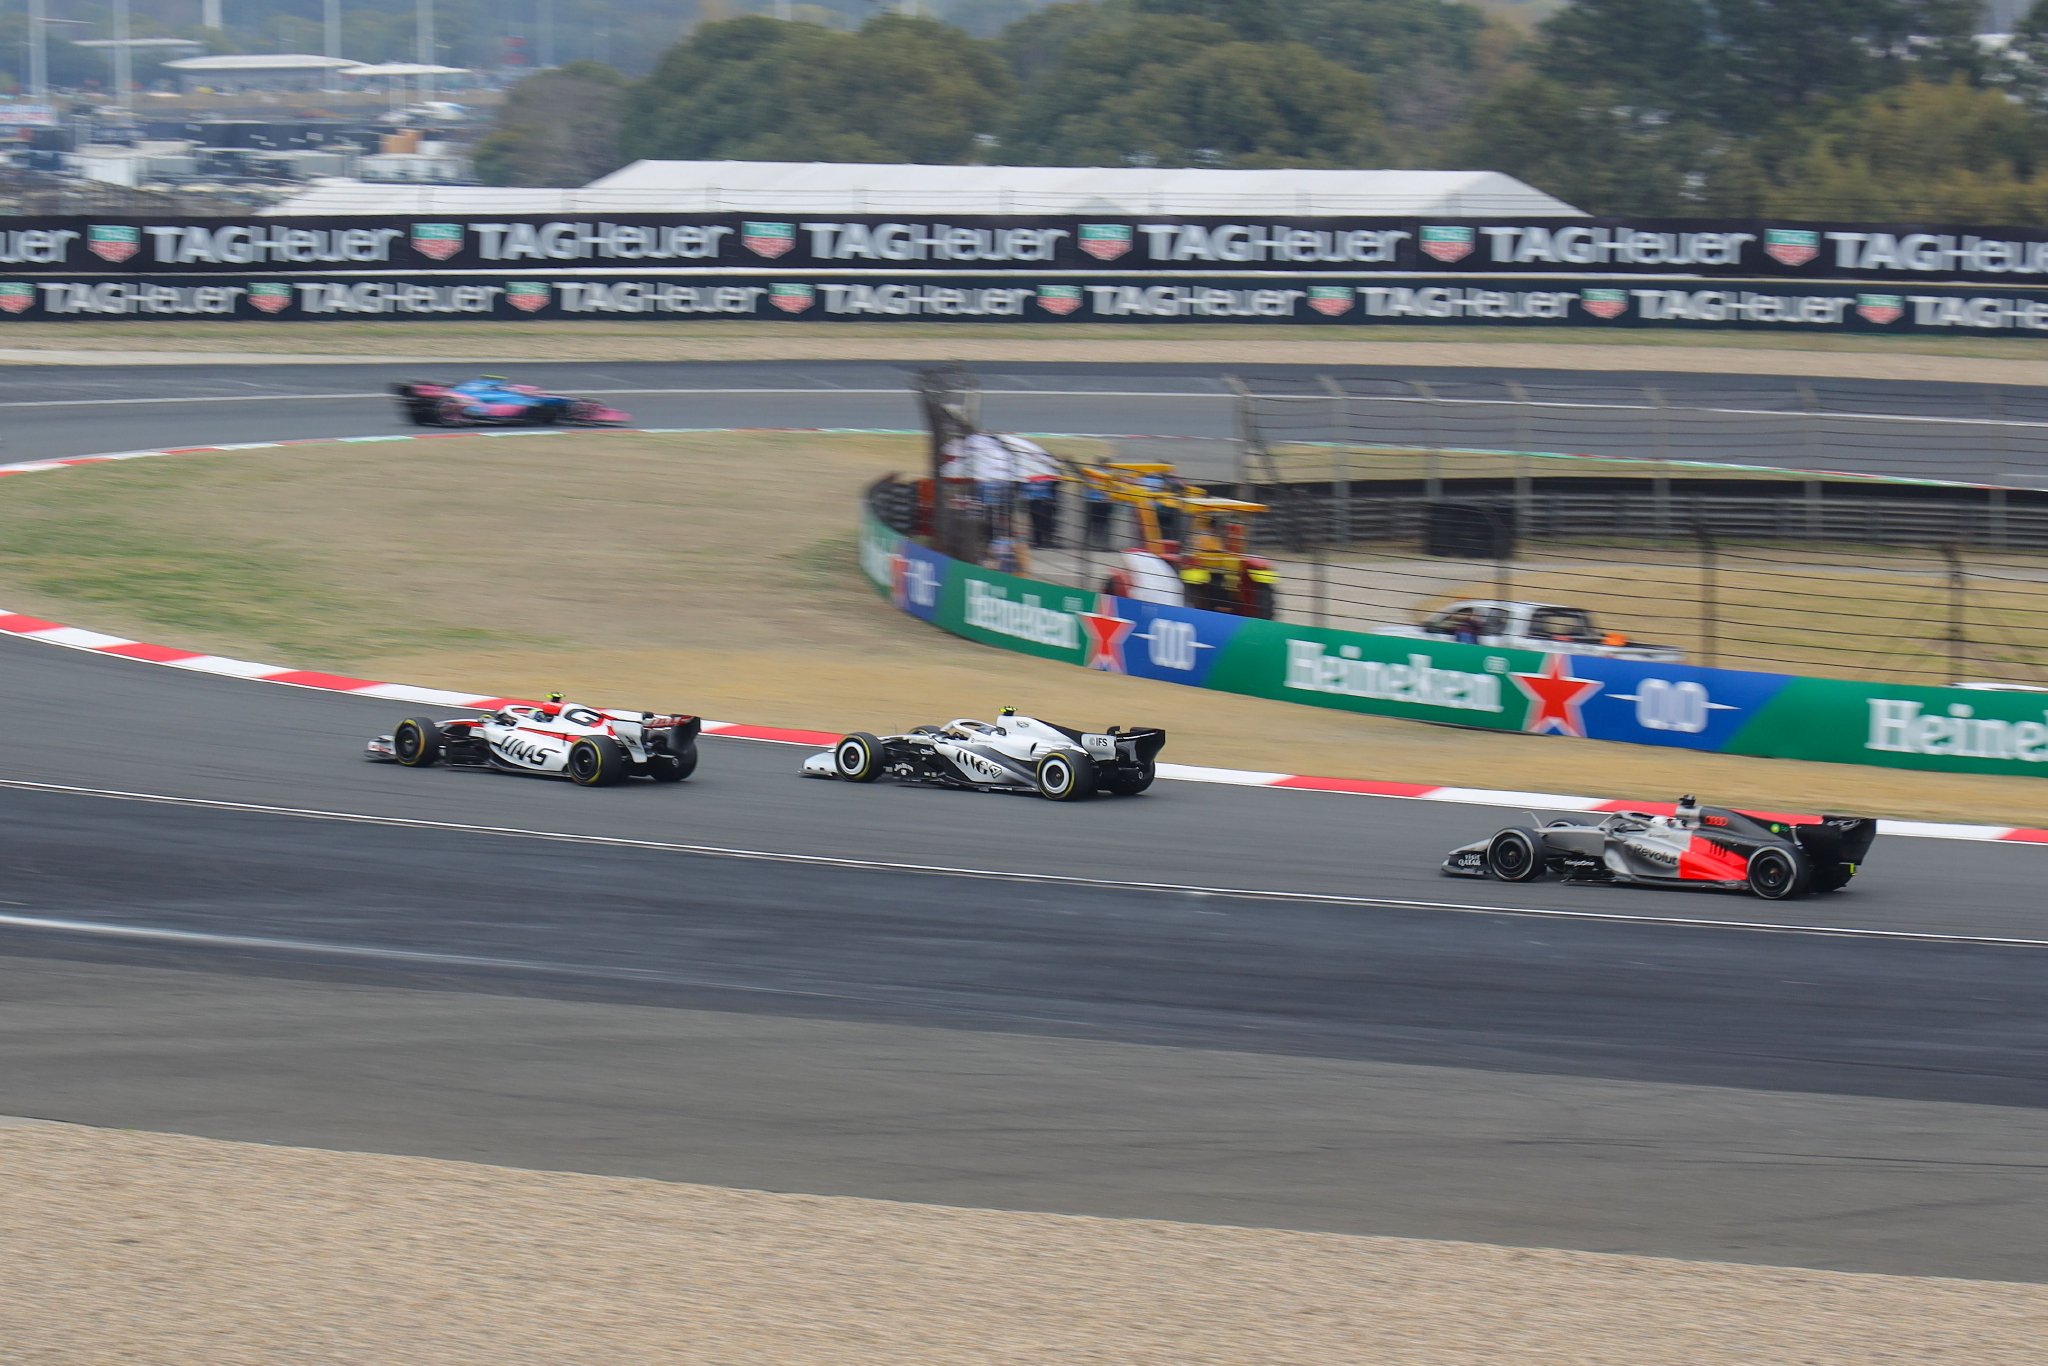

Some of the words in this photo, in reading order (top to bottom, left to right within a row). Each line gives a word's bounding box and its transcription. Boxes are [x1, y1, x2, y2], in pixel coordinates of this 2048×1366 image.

[1284, 638, 1504, 713] Heineken
[1864, 698, 2048, 763] Heine
[1634, 844, 1679, 866] Revolut
